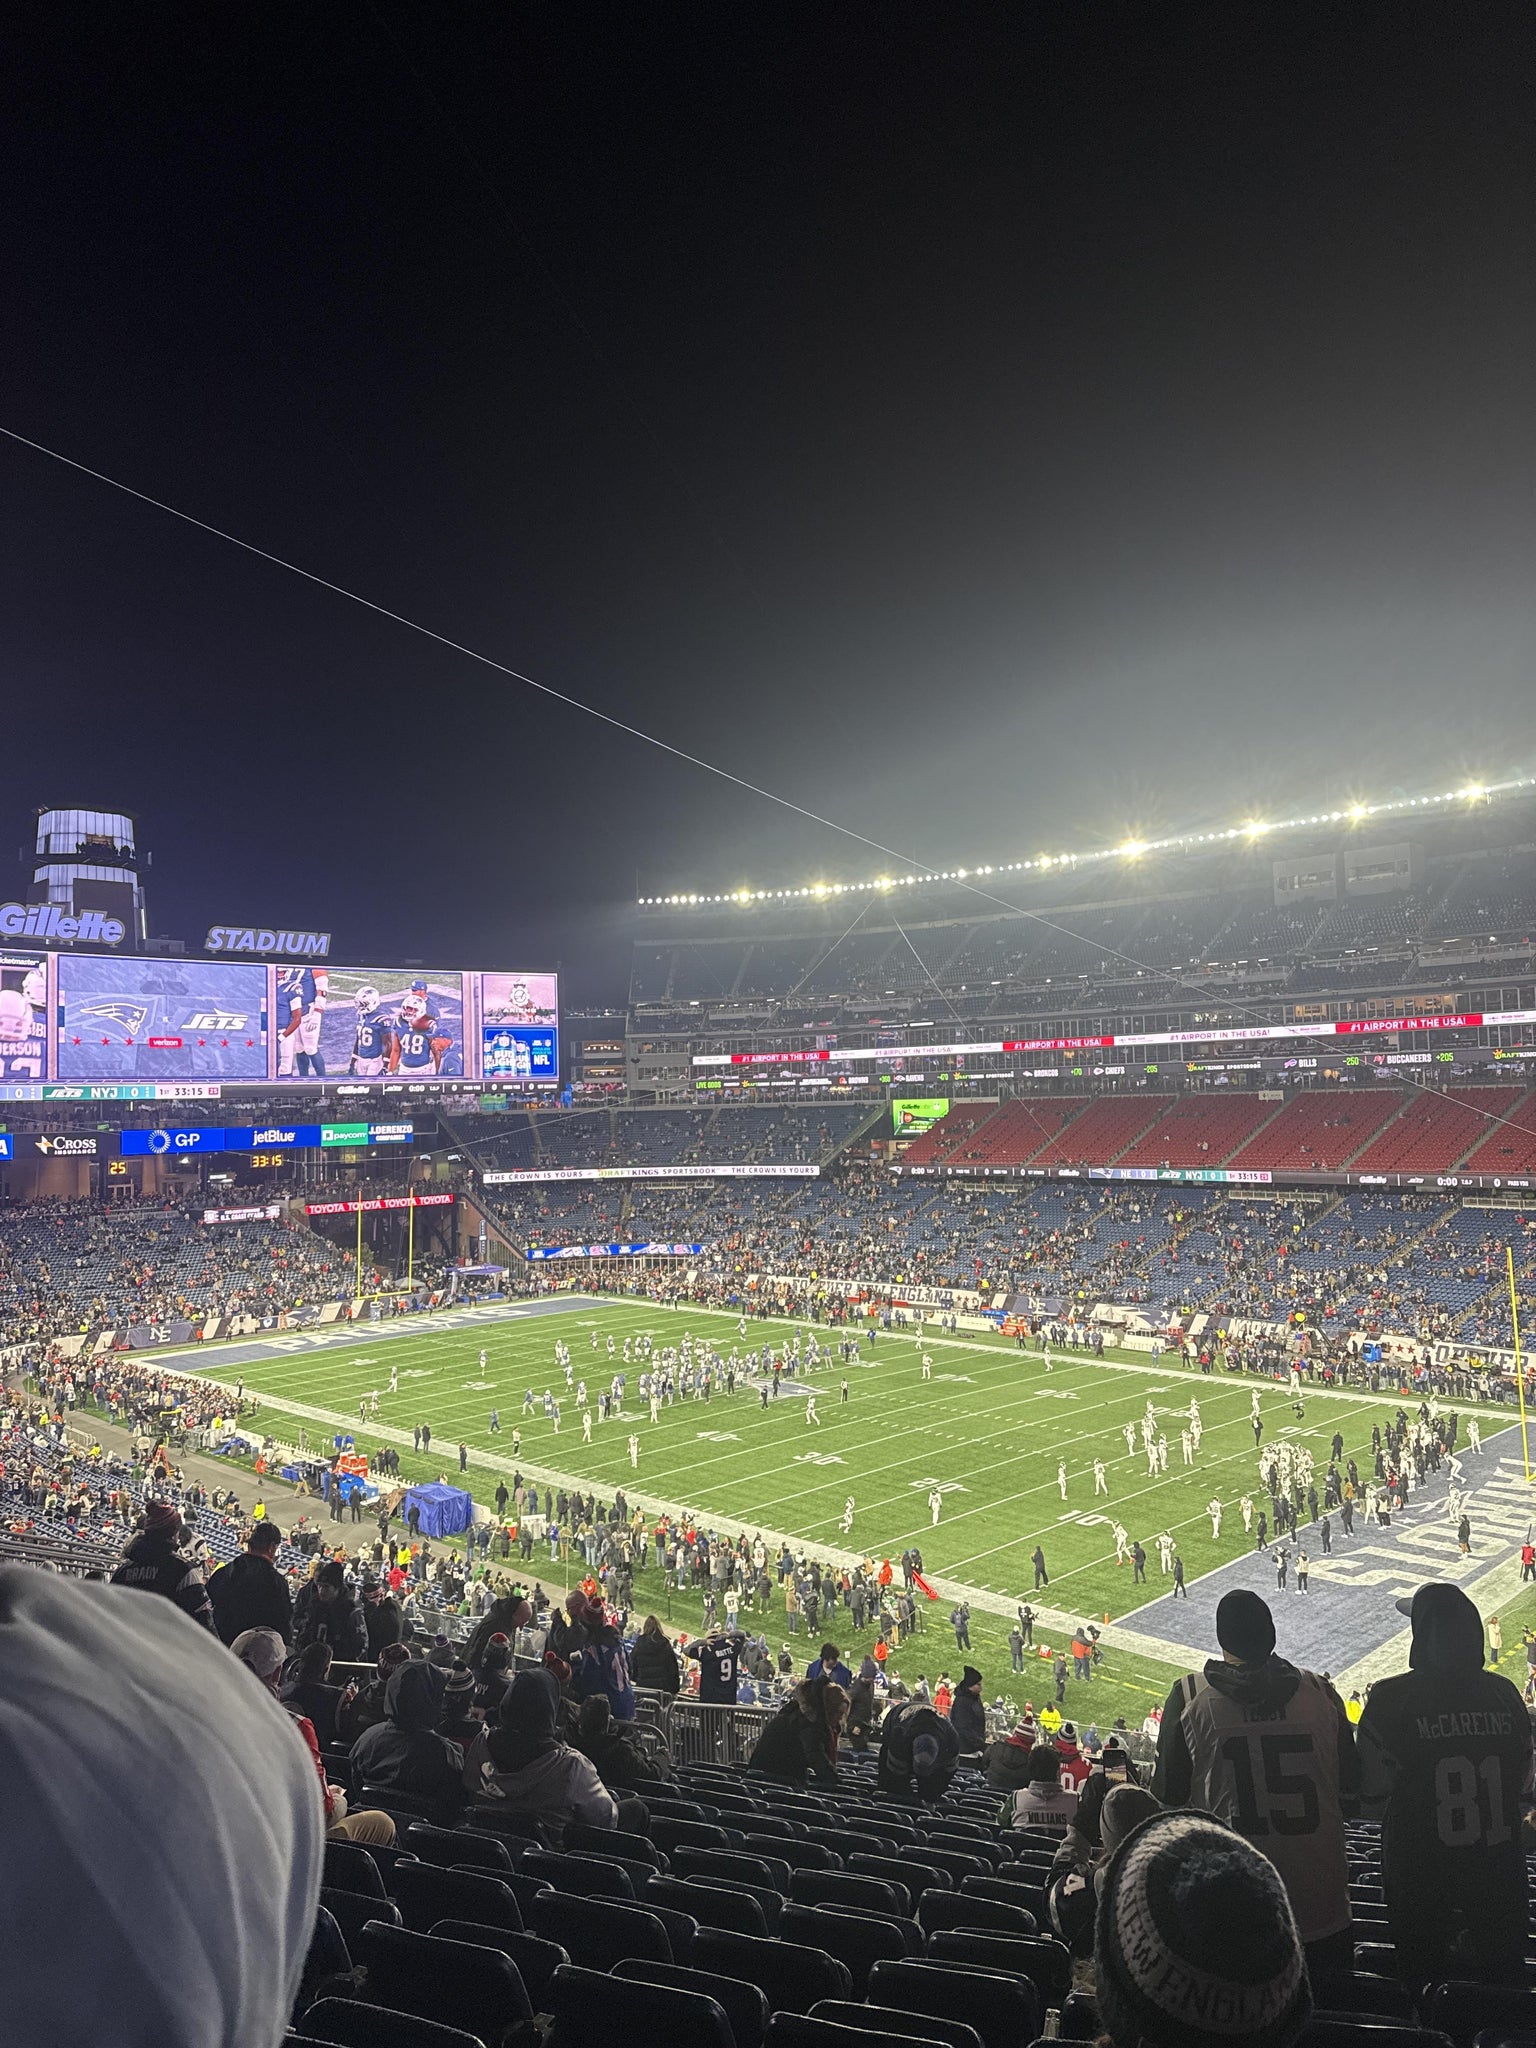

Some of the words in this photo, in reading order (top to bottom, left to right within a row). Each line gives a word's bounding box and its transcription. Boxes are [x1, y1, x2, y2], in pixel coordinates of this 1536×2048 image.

[0, 904, 123, 942] Gillette
[208, 928, 328, 954] STADIUM
[181, 1008, 248, 1030] JETS
[1351, 1024, 1361, 1032] #1
[1363, 1021, 1403, 1031] AIRPORT
[1407, 1020, 1417, 1028] IN
[1420, 1018, 1439, 1027] THE
[1442, 1017, 1466, 1026] USA!
[1181, 1032, 1216, 1041] AIRPORT
[1250, 1029, 1270, 1037] USA!
[0, 1042, 41, 1056] ERSON
[401, 1033, 424, 1055] 48
[1024, 1041, 1055, 1049] AIRPORT
[494, 1050, 514, 1058] BUD
[533, 1055, 550, 1065] NFL
[751, 1054, 780, 1062] AIRPORT
[790, 1053, 803, 1061] THE
[1342, 1056, 1359, 1066] -250
[1387, 1053, 1432, 1064] BUCCANEERS
[1436, 1052, 1453, 1062] +205
[1298, 1058, 1317, 1067] BILLS
[1034, 1069, 1059, 1077] BRONCOS
[1105, 1066, 1125, 1075] CHIEFS
[15, 1089, 23, 1098] 0
[46, 1086, 83, 1098] JETS
[91, 1088, 118, 1098] NYJ
[131, 1088, 139, 1097] 0
[174, 1087, 203, 1096] 33:15
[53, 1136, 96, 1149] CROSS
[253, 1129, 295, 1146] jetBlue
[333, 1130, 367, 1141] paycom
[110, 1161, 126, 1175] 25
[252, 1155, 282, 1168] 33:15
[1120, 1169, 1131, 1178] NE
[1185, 1170, 1202, 1179] NYJ
[1437, 1177, 1458, 1186] 0:00
[1494, 1178, 1501, 1187] 0
[310, 1204, 345, 1213] TOYOTA
[347, 1201, 381, 1210] TOYOTA
[384, 1198, 416, 1208] TOYOTA
[420, 1195, 451, 1205] TOYOTA
[1028, 1297, 1045, 1313] NE
[150, 1326, 171, 1343] NE
[261, 1308, 531, 1350] PATRIOTS
[792, 1450, 842, 1466] 30
[907, 1476, 964, 1494] 20
[1055, 1509, 1113, 1527] 10
[179, 1549, 193, 1559] 12
[125, 1566, 159, 1582] BRADY
[720, 1658, 732, 1682] 9
[1416, 1711, 1512, 1740] McCAREINS
[1060, 1772, 1074, 1792] 0
[1222, 1733, 1321, 1836] 15
[1434, 1755, 1512, 1849] 81
[1027, 1810, 1067, 1825] WILLIAMS
[1063, 1872, 1087, 1897] 4
